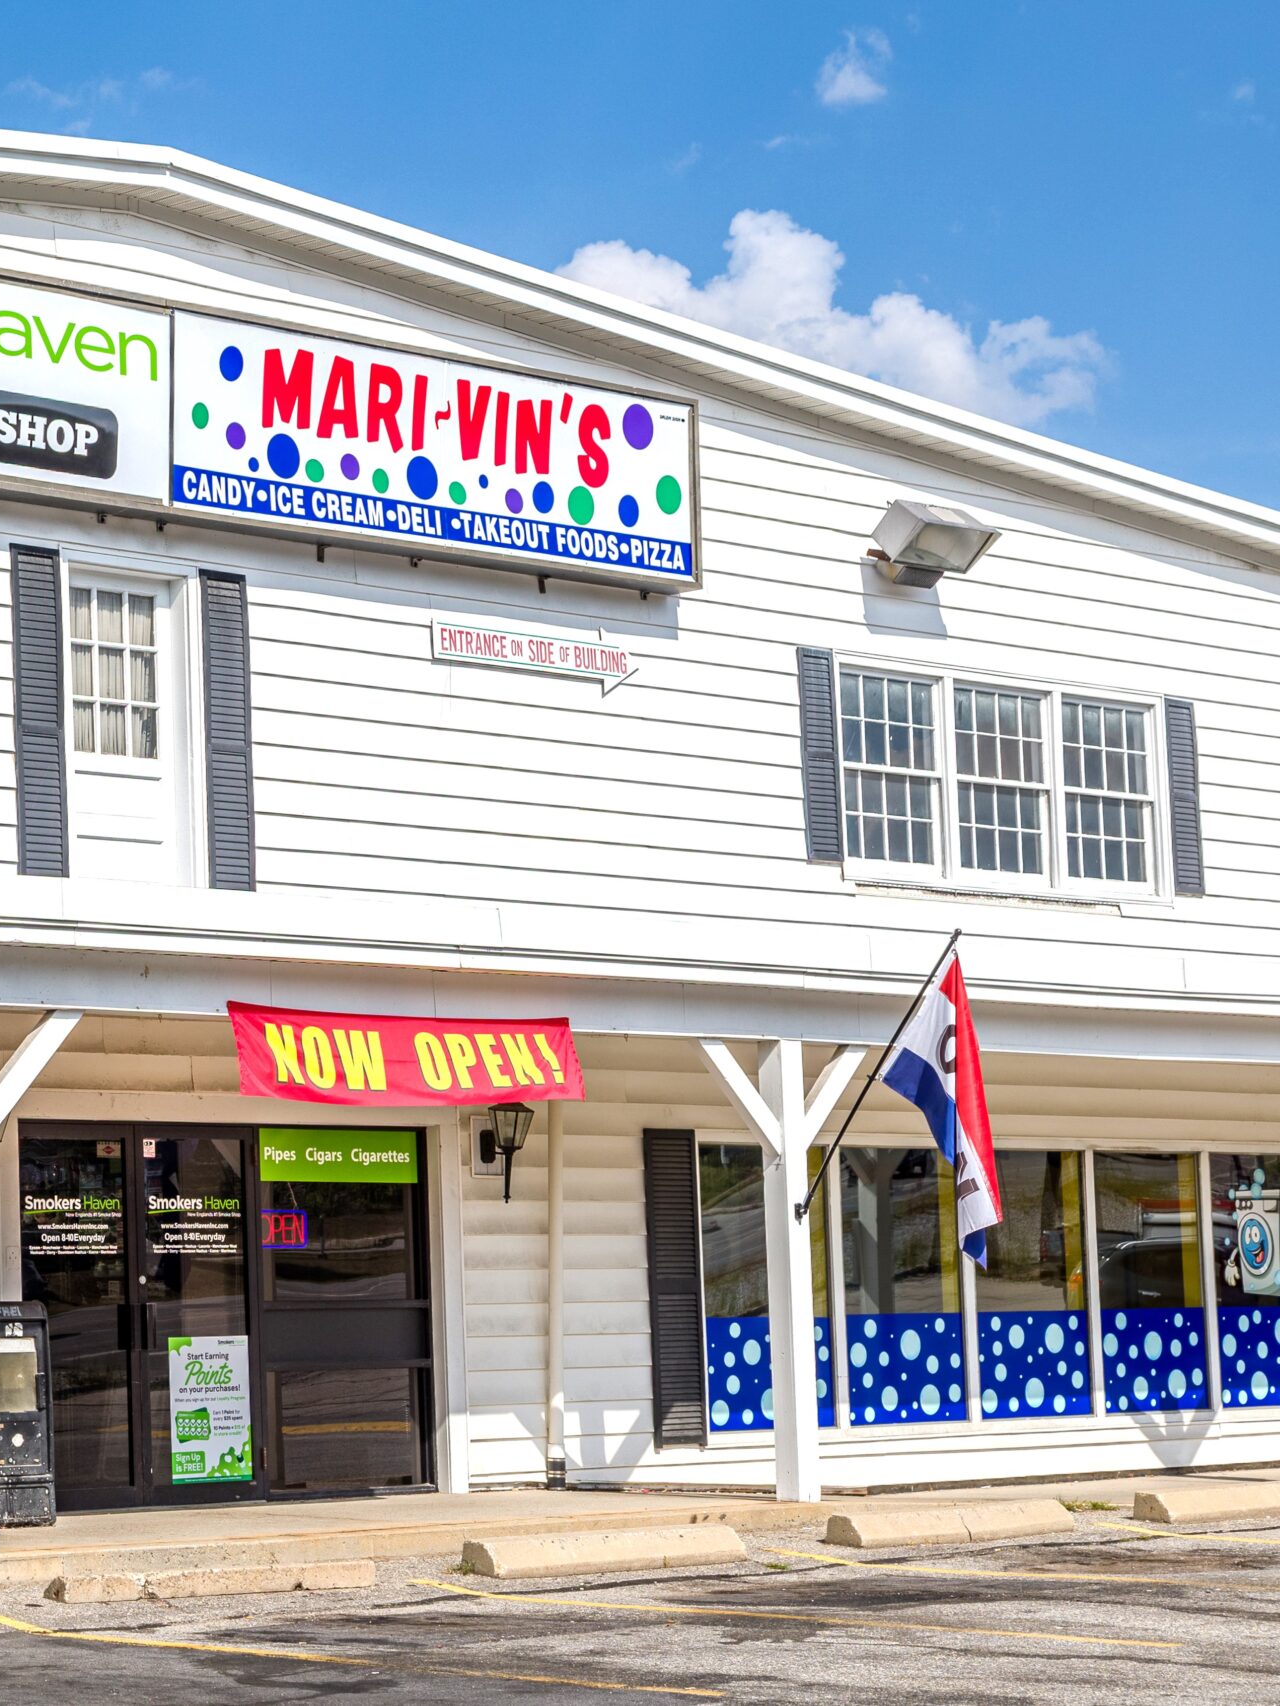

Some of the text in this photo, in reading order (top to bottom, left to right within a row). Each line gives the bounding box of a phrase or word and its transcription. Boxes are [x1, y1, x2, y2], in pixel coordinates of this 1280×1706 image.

[182, 470, 686, 571] CANDY ICE CREAM DELI TAKEOUT FOODS PIZZA
[440, 627, 628, 675] ENTRANCE ON SIDE OF BUILDING
[264, 1022, 565, 1092] NOW OPEN!
[263, 1147, 410, 1166] Pipes Cigars Cigarettes
[24, 1195, 120, 1210] Smokers Haven
[148, 1195, 240, 1210] Smokers Haven
[41, 1233, 60, 1243] Open
[74, 1233, 106, 1243] Everyday
[164, 1232, 183, 1242] Open
[195, 1232, 226, 1242] Everyday
[187, 1352, 229, 1361] Start Earning
[184, 1360, 233, 1386] Points
[188, 1387, 204, 1395] your
[204, 1384, 241, 1394] purchases!
[175, 1453, 201, 1463] Sign Up
[175, 1463, 204, 1472] is FREE!
